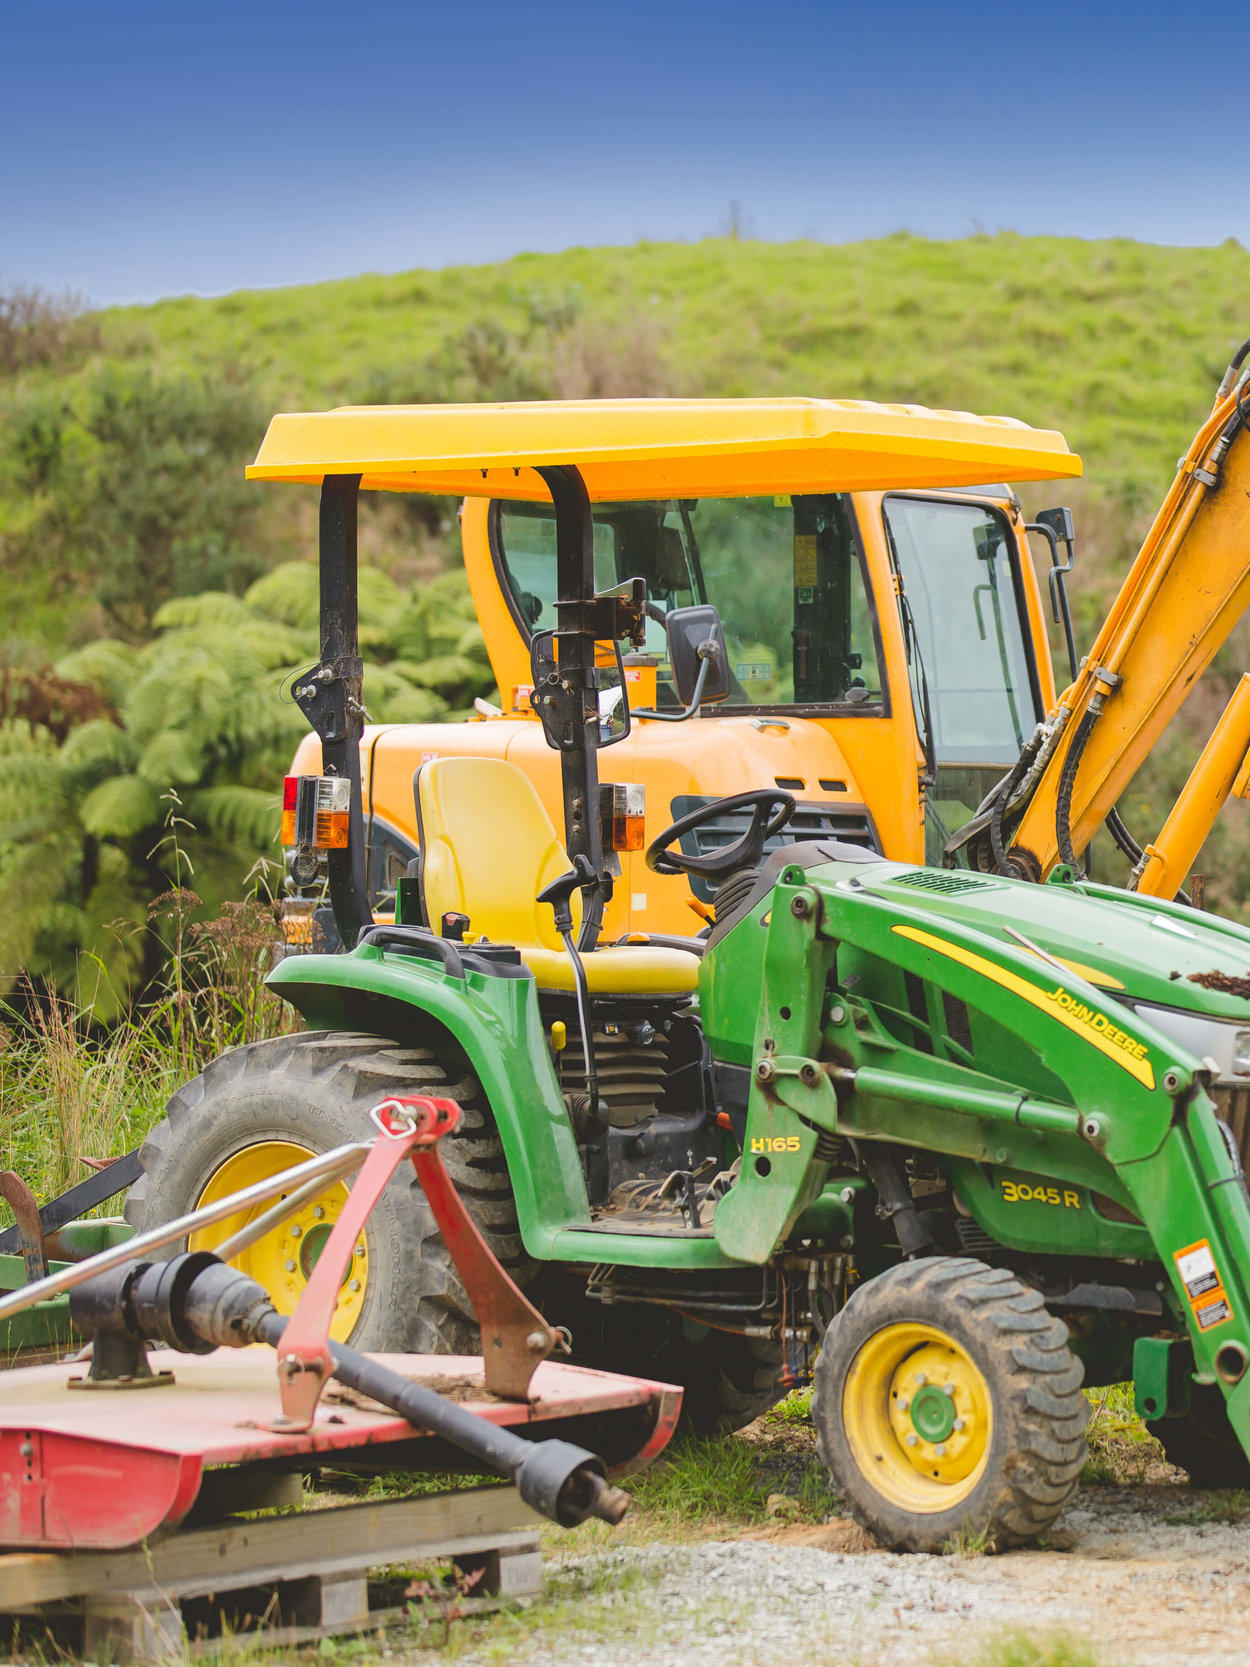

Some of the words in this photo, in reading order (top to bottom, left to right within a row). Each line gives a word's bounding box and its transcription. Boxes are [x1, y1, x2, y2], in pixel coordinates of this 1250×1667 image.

[1045, 986, 1095, 1024] JOHN
[1088, 1012, 1149, 1061] DEERE
[750, 1136, 800, 1154] H165
